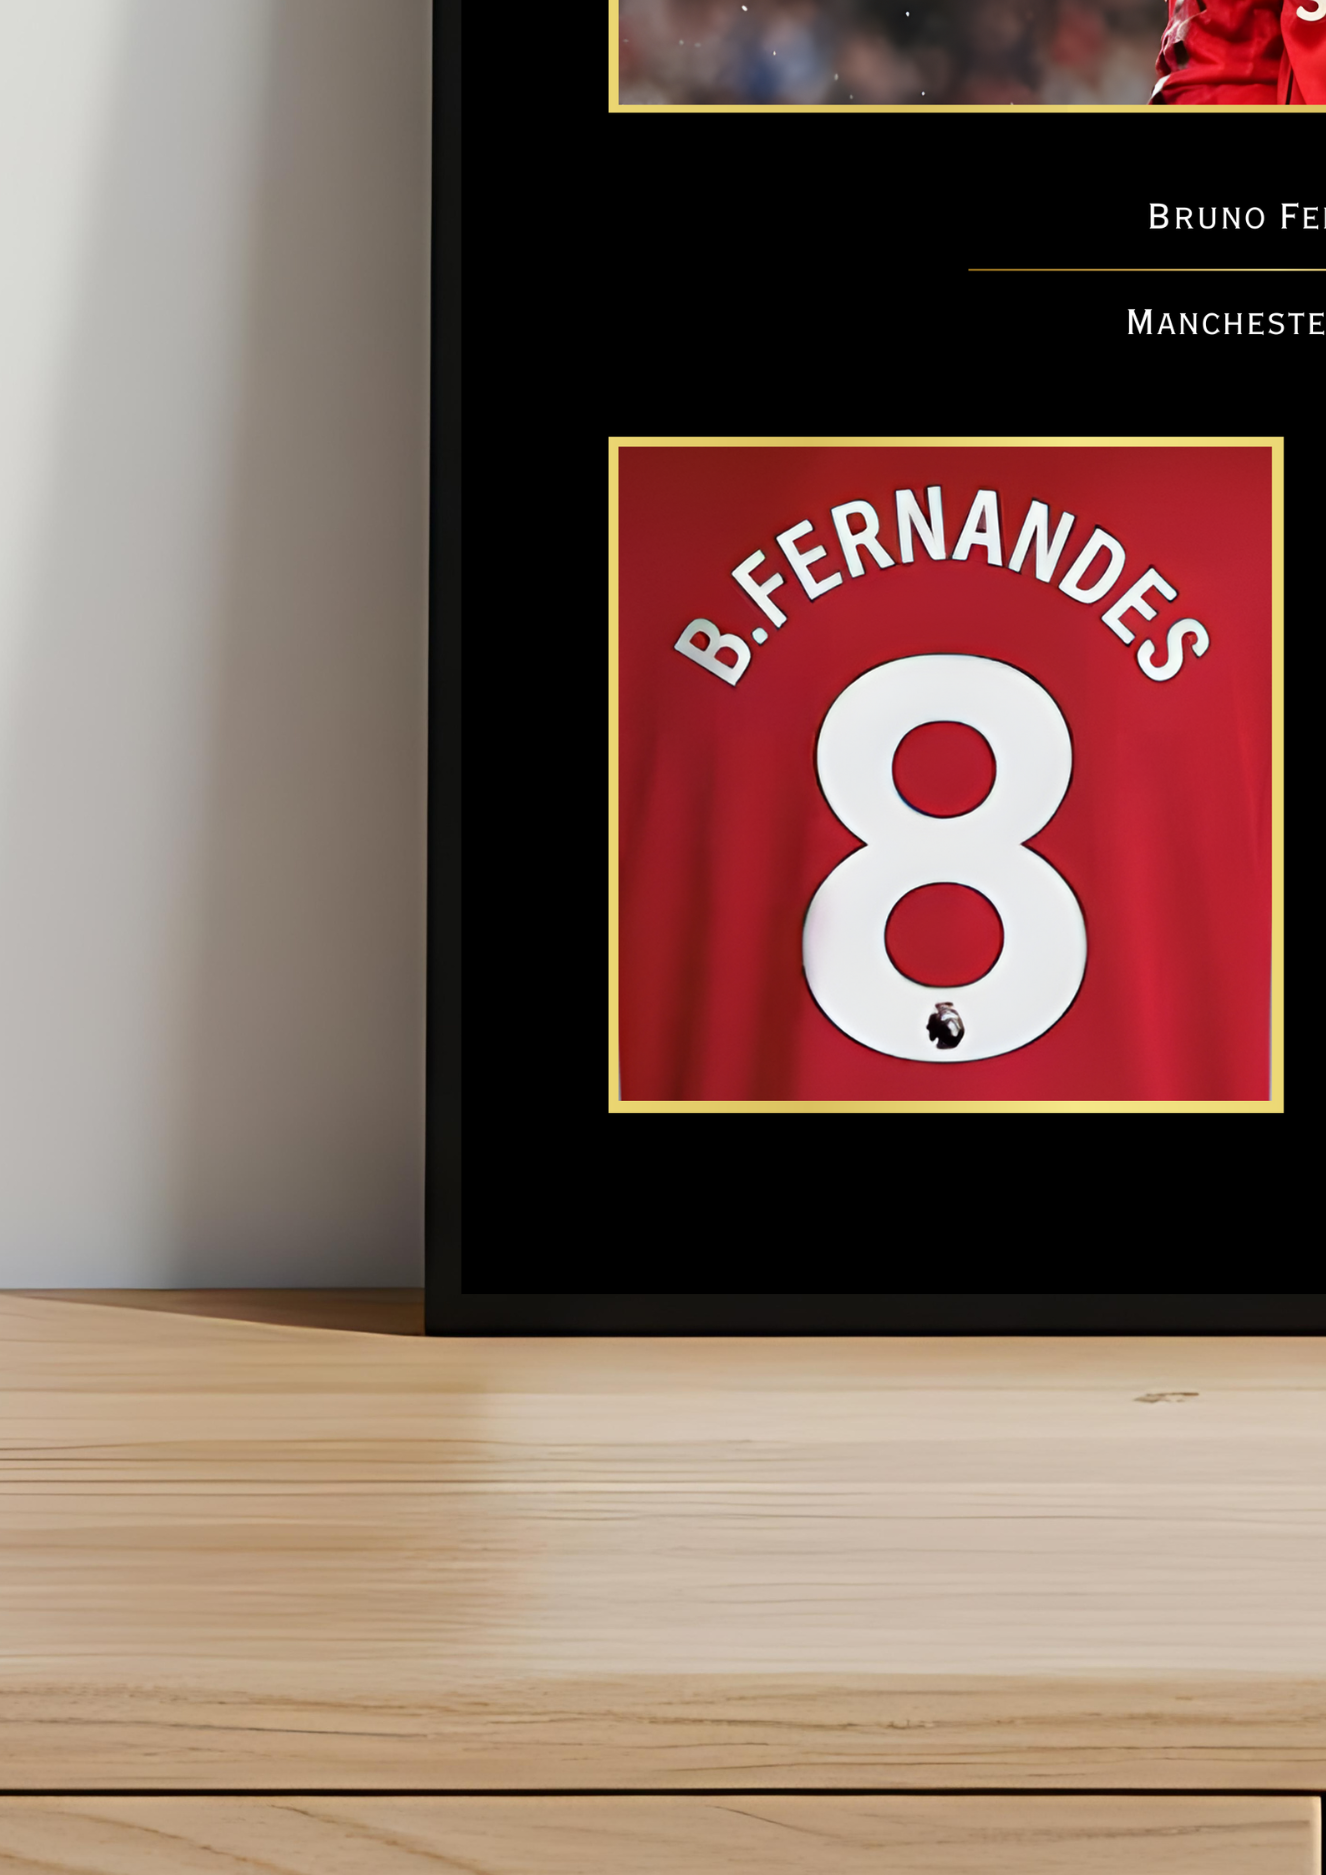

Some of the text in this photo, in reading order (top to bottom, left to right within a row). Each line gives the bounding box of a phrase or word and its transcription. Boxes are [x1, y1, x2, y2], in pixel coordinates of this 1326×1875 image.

[1149, 202, 1265, 230] BRUNO
[674, 485, 1210, 687] B.FERNANDES
[802, 653, 1088, 1063] 8
